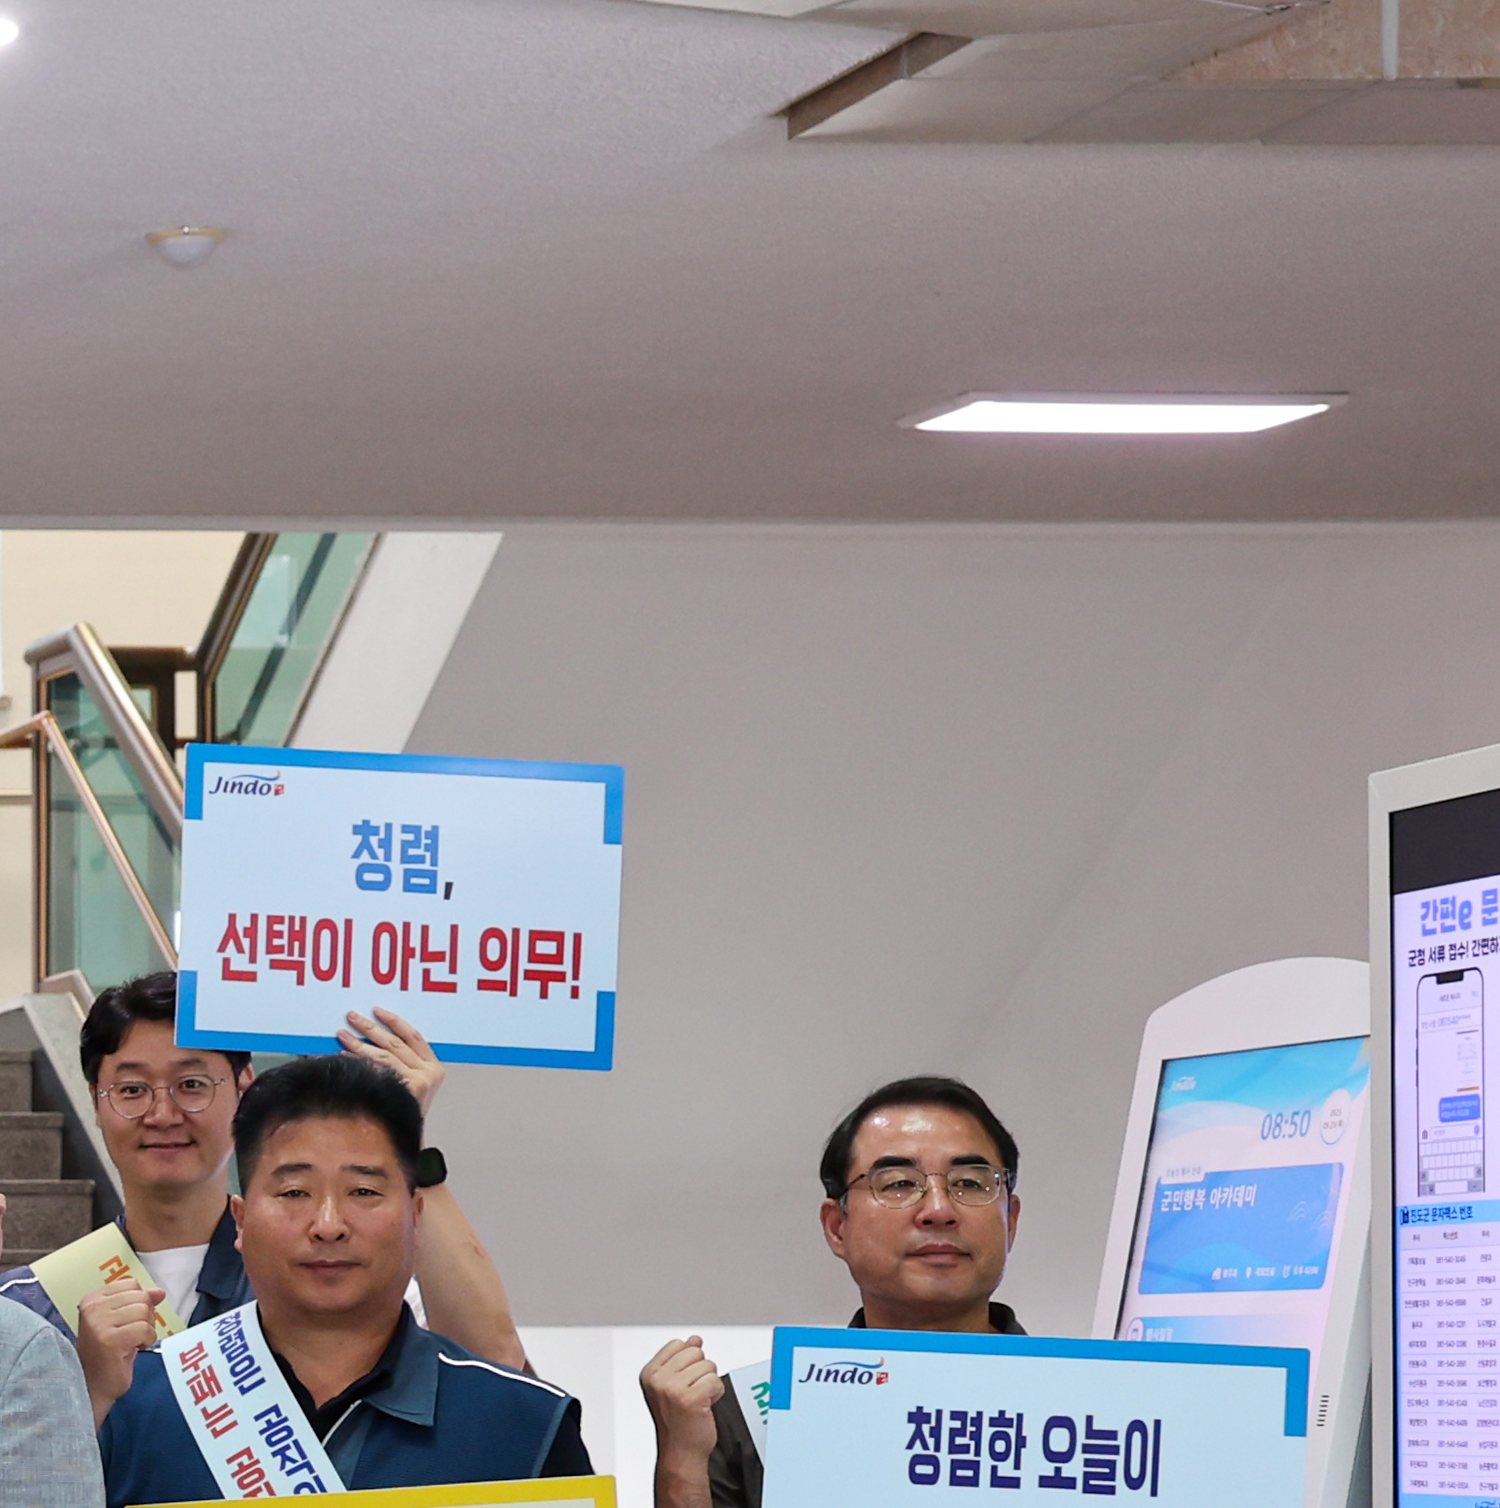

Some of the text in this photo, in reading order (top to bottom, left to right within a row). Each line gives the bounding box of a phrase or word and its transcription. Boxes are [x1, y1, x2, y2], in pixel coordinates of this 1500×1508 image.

[209, 772, 272, 797] Jindo
[350, 818, 454, 901] 청렴,
[216, 912, 583, 1000] 선택이 아닌 의무!
[1260, 1109, 1312, 1140] 08:50
[799, 1359, 874, 1387] Jindo
[904, 1404, 1163, 1498] 청렴한 오늘이
